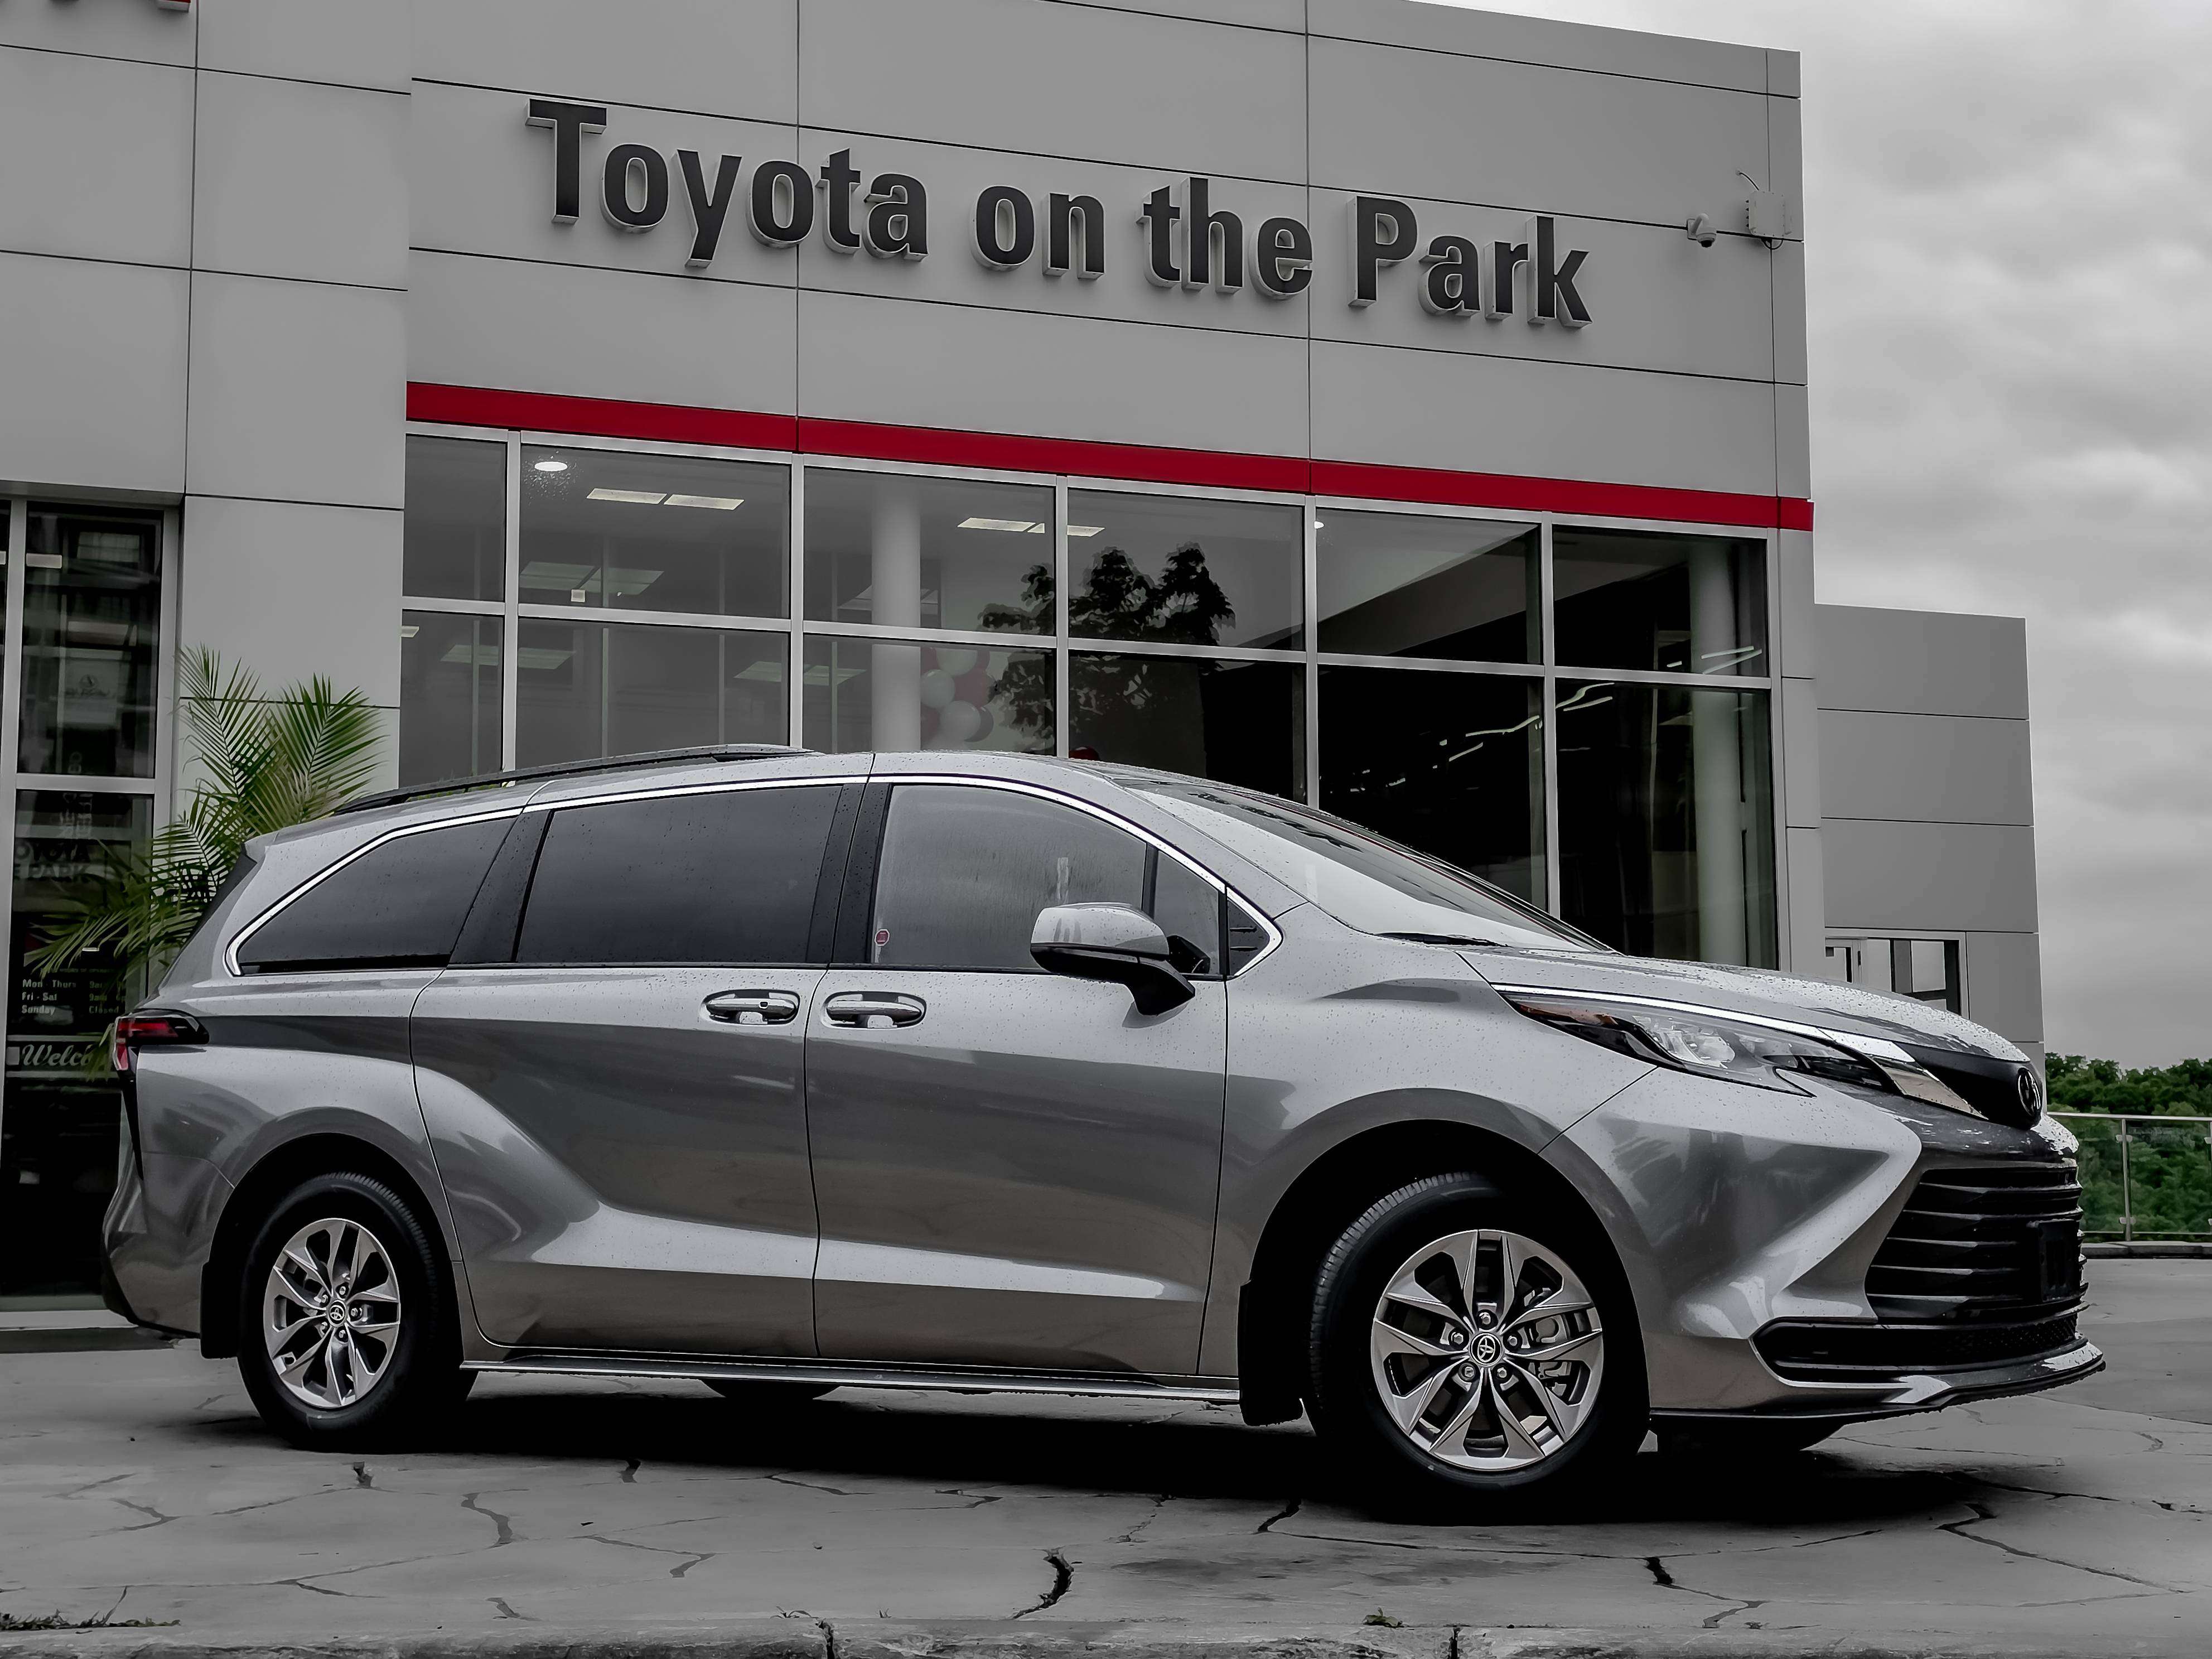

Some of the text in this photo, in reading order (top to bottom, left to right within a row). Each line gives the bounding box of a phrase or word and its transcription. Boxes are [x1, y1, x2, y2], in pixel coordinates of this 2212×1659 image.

[525, 98, 1593, 329] Toyota on the Park
[22, 978, 43, 987] Mon
[22, 992, 33, 1000] Fri
[42, 992, 57, 1001] Sat
[21, 1004, 56, 1016] Sunday
